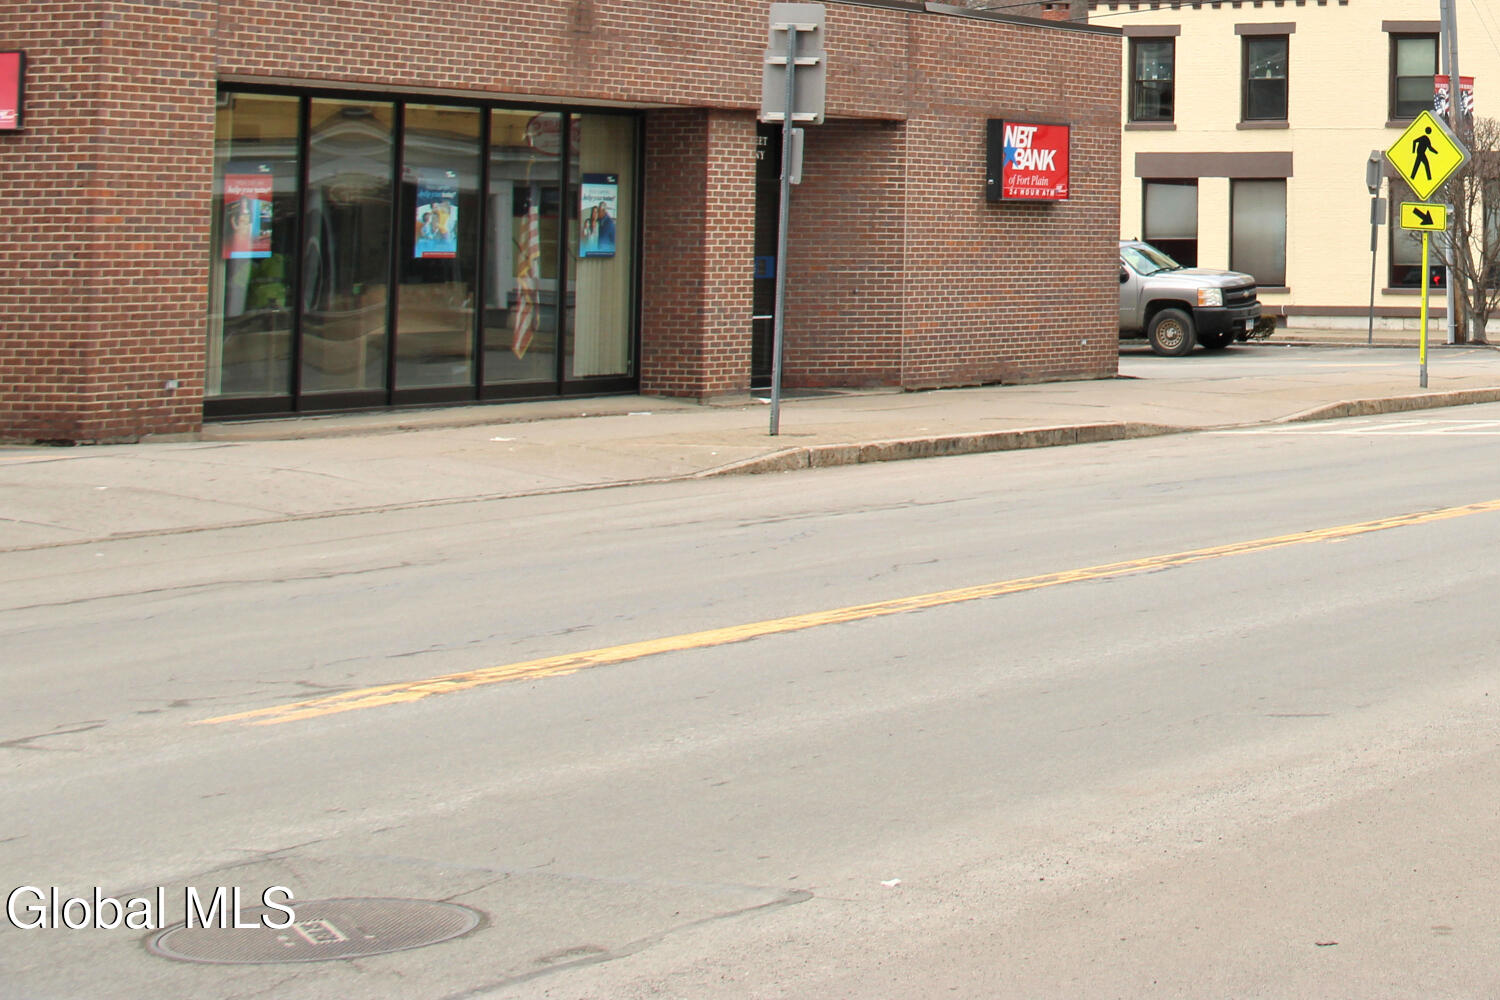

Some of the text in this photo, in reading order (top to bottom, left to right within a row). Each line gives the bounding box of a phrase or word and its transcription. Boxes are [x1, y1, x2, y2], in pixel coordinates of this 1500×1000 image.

[1004, 125, 1038, 148] NBT
[1012, 148, 1057, 171] BANK
[1008, 174, 1049, 188] of Fort Plain
